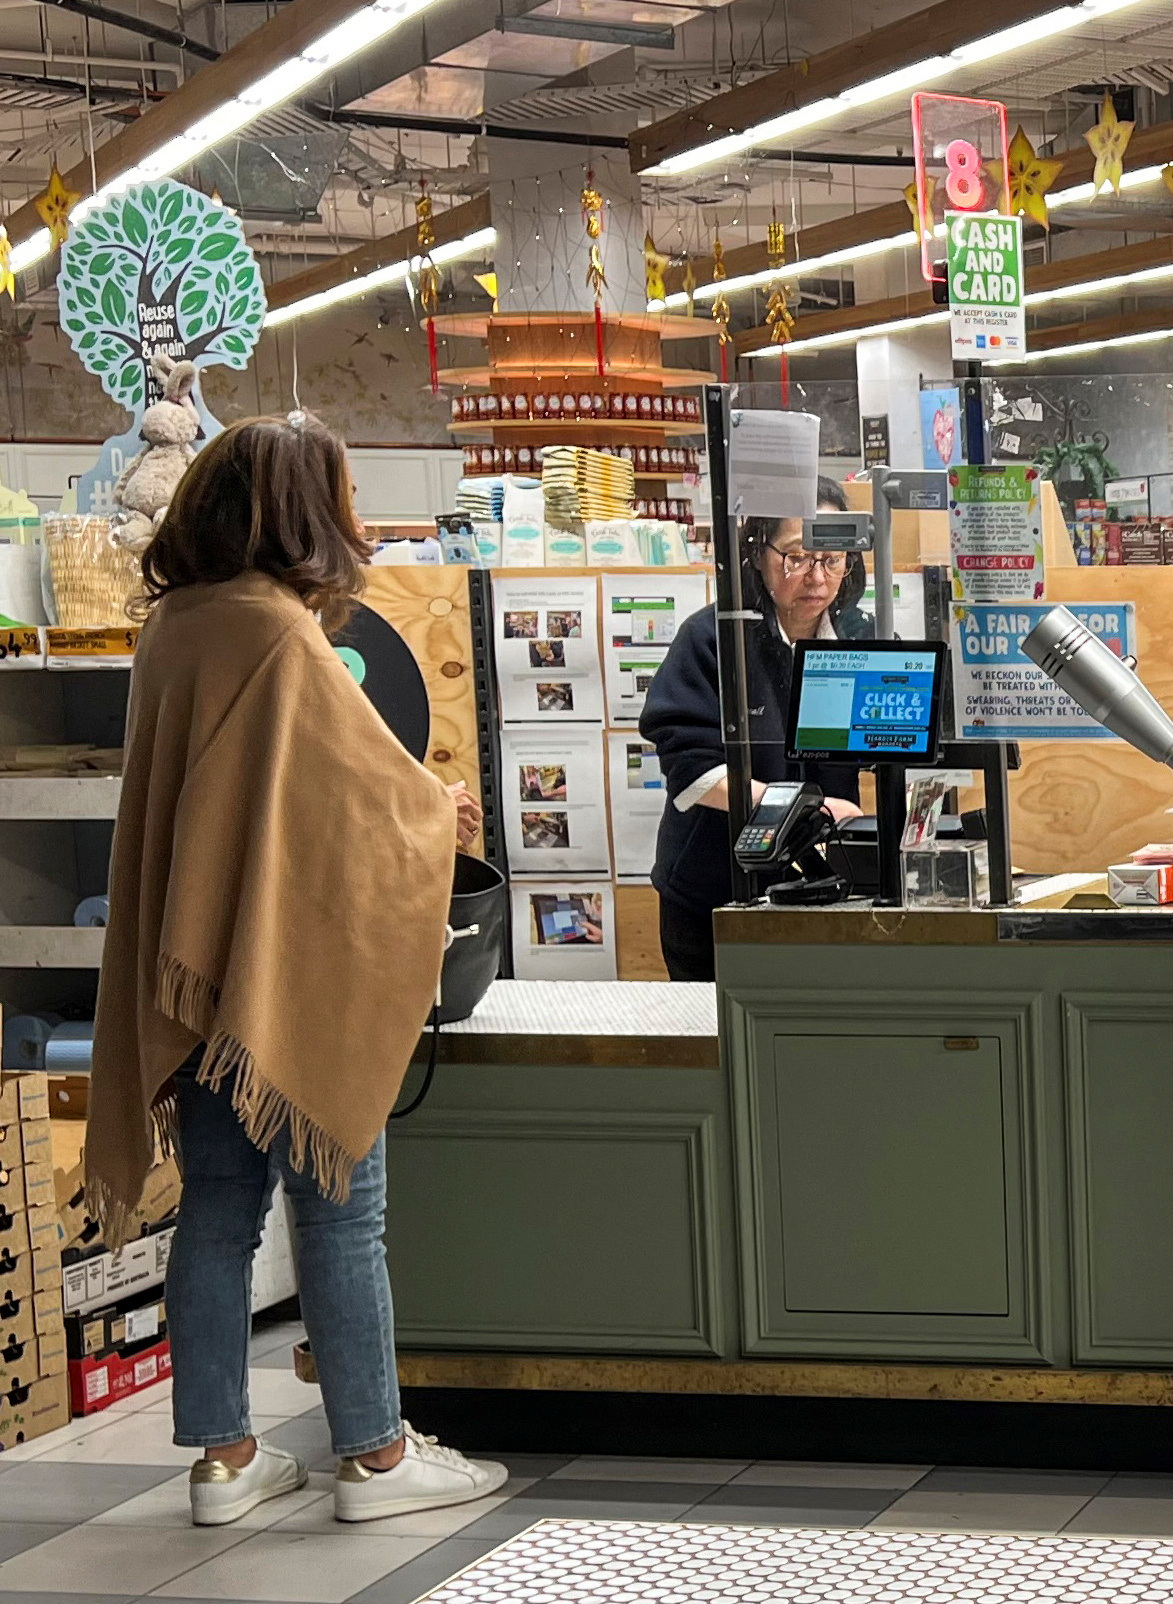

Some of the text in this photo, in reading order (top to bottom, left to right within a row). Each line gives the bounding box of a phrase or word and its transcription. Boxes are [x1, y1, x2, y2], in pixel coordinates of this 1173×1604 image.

[945, 139, 982, 209] 8
[951, 219, 1013, 251] CASH
[965, 251, 1004, 273] AND
[953, 272, 1016, 303] CARD
[138, 302, 175, 322] Reuse
[142, 323, 174, 339] again
[141, 344, 152, 359] &
[968, 475, 1018, 488] REFUNDS &
[999, 489, 1027, 499] POLICY
[963, 556, 1029, 568] CHANGE POLICY
[965, 614, 980, 633] A
[987, 614, 1031, 633] FAIR
[966, 636, 1008, 655] OUR
[807, 653, 869, 661] HFM PAPER BAGS
[971, 671, 1043, 680] WE RECKON OUR
[983, 682, 992, 691] BE
[996, 682, 1035, 691] TREATED
[865, 692, 921, 706] CLICK &
[967, 696, 1071, 706] SWEARING, THREATS OR
[966, 707, 977, 715] OF
[980, 707, 1022, 716] VIOLENCE
[1025, 707, 1052, 716] WON'T
[1057, 707, 1067, 716] BE
